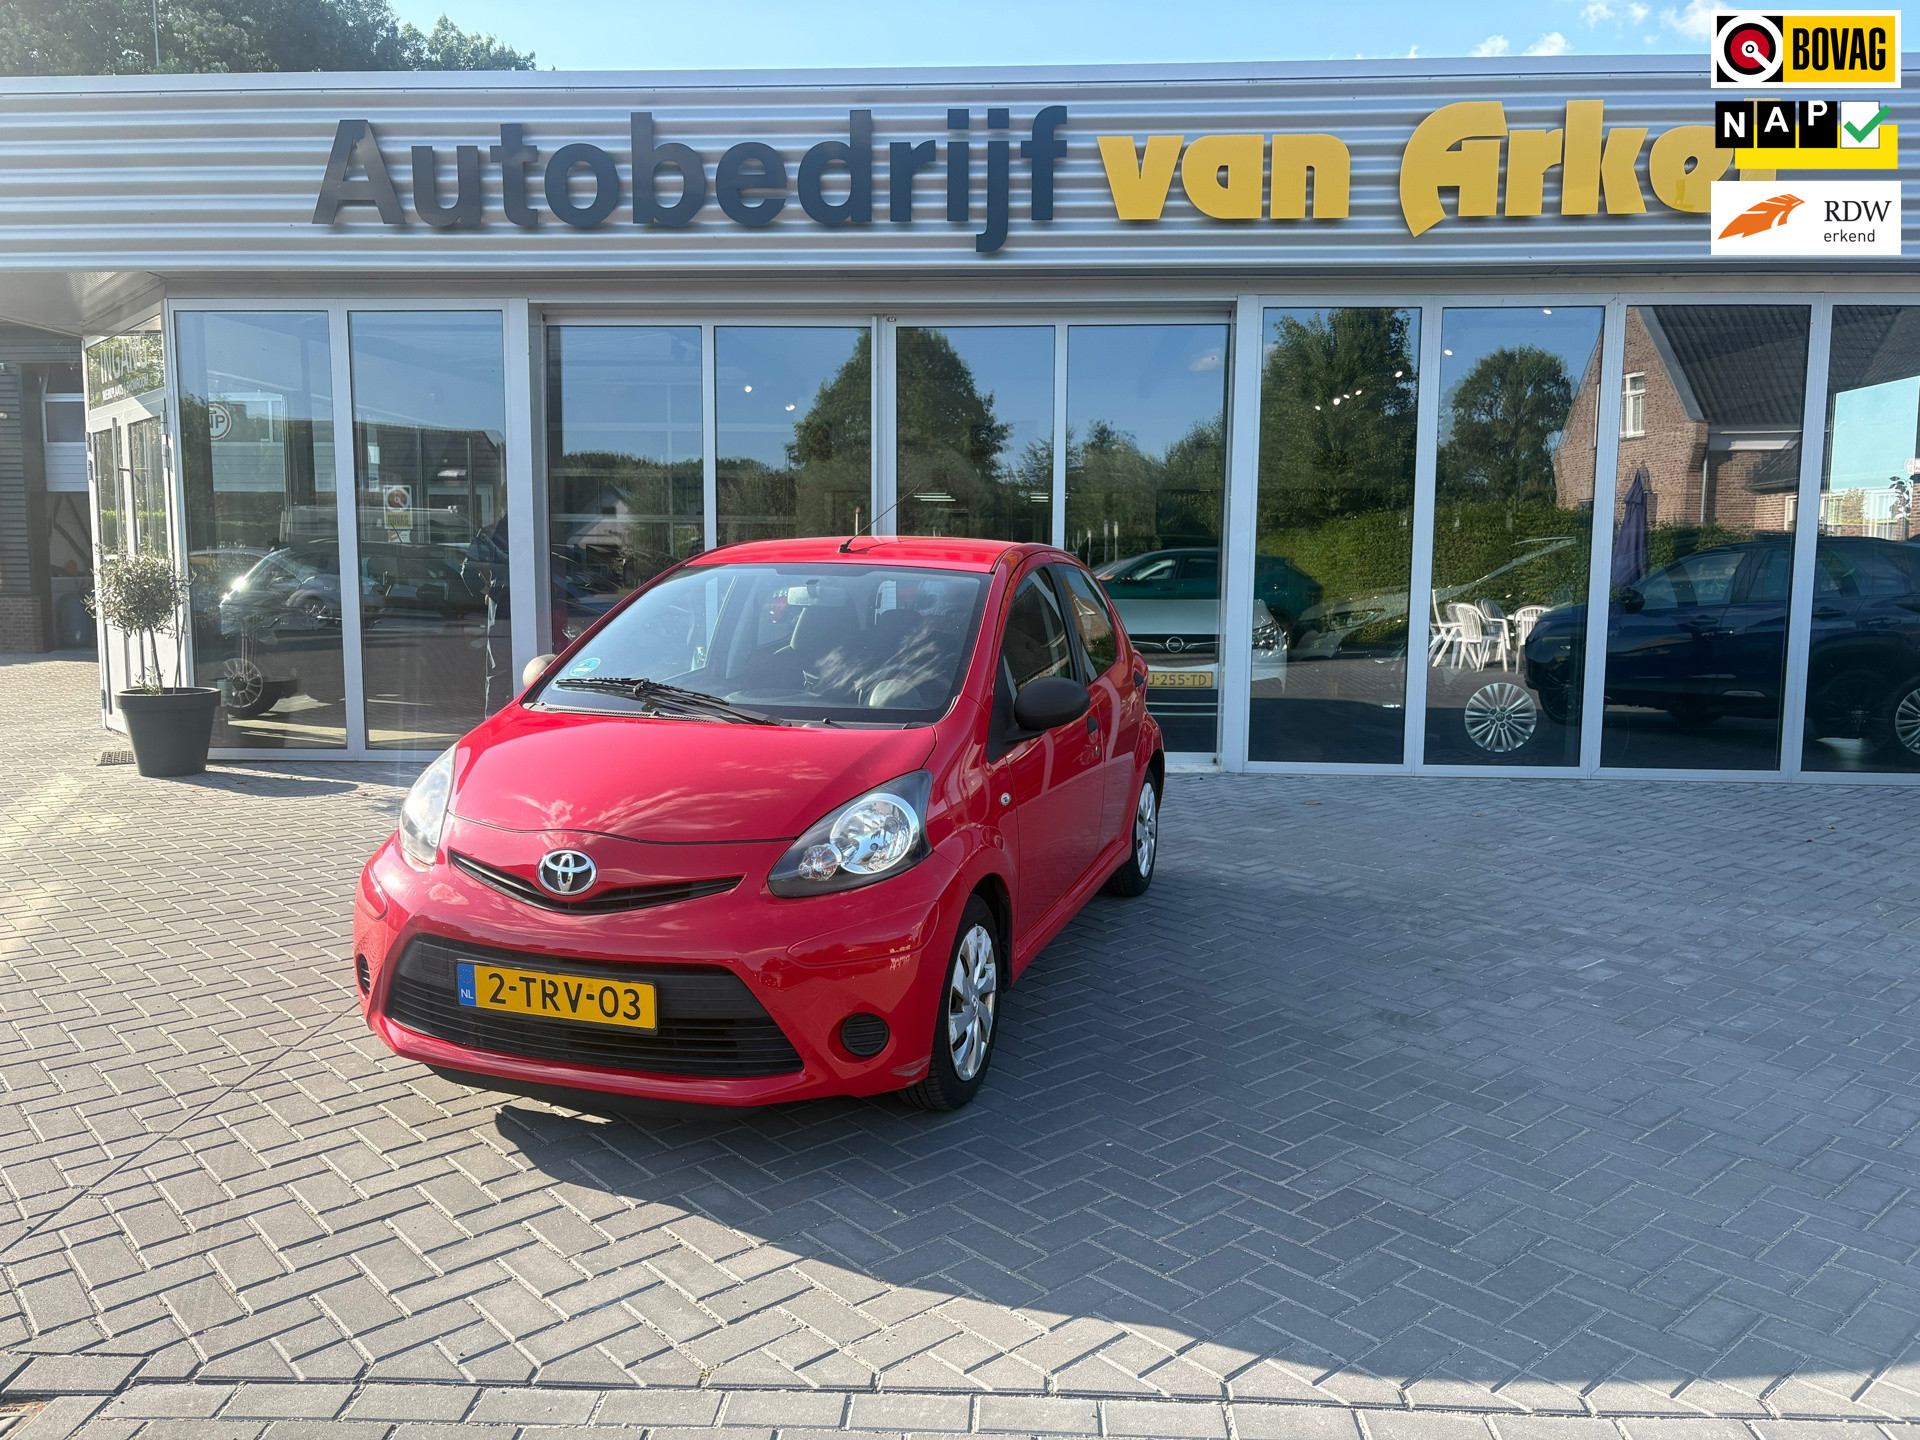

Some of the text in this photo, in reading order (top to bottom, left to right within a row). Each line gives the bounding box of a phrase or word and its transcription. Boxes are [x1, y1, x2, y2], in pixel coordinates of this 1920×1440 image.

[311, 97, 1781, 253] Autobedrijf van Arke
[100, 336, 147, 384] INGANG
[1149, 674, 1207, 686] J-255-TD
[460, 988, 474, 1000] NL
[488, 972, 641, 1021] 2-TRV-03
